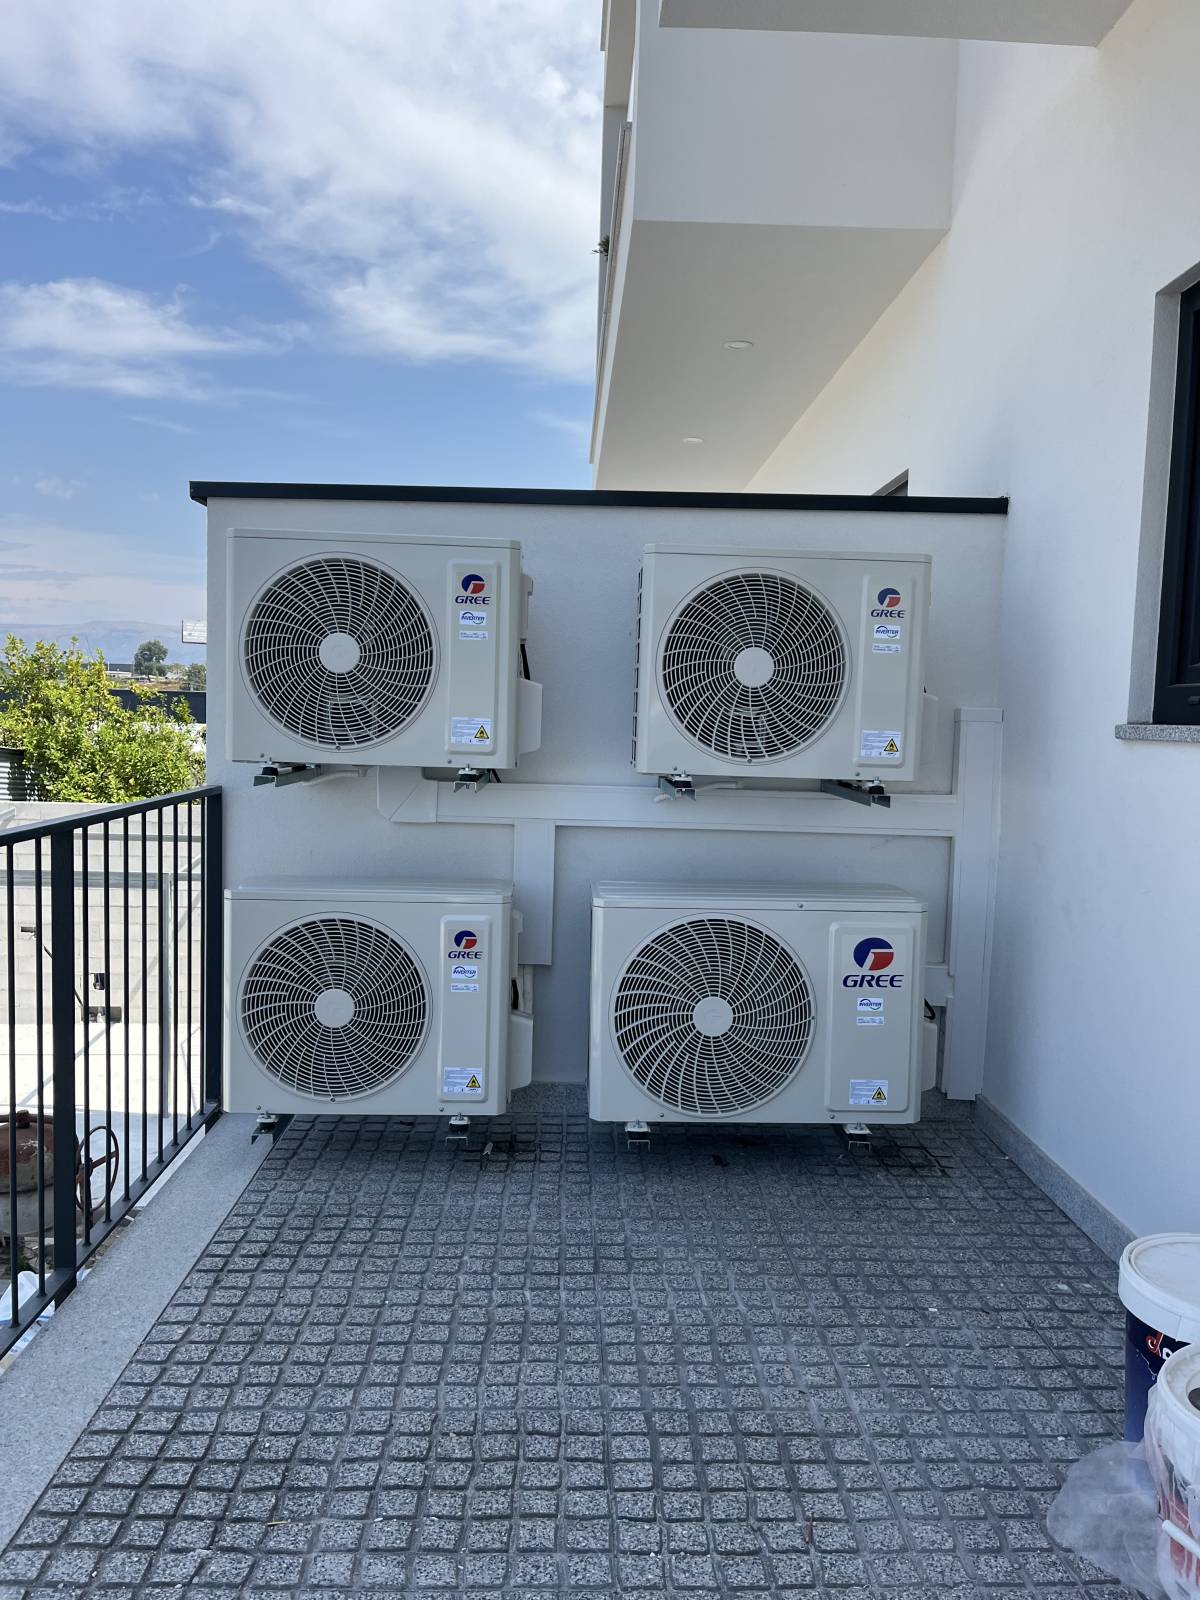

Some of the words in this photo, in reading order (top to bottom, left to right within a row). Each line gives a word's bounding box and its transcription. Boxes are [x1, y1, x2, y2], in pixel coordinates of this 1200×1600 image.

[455, 595, 491, 605] GREE
[870, 609, 906, 619] GREE
[447, 950, 483, 960] GREE
[842, 974, 904, 988] GREE
